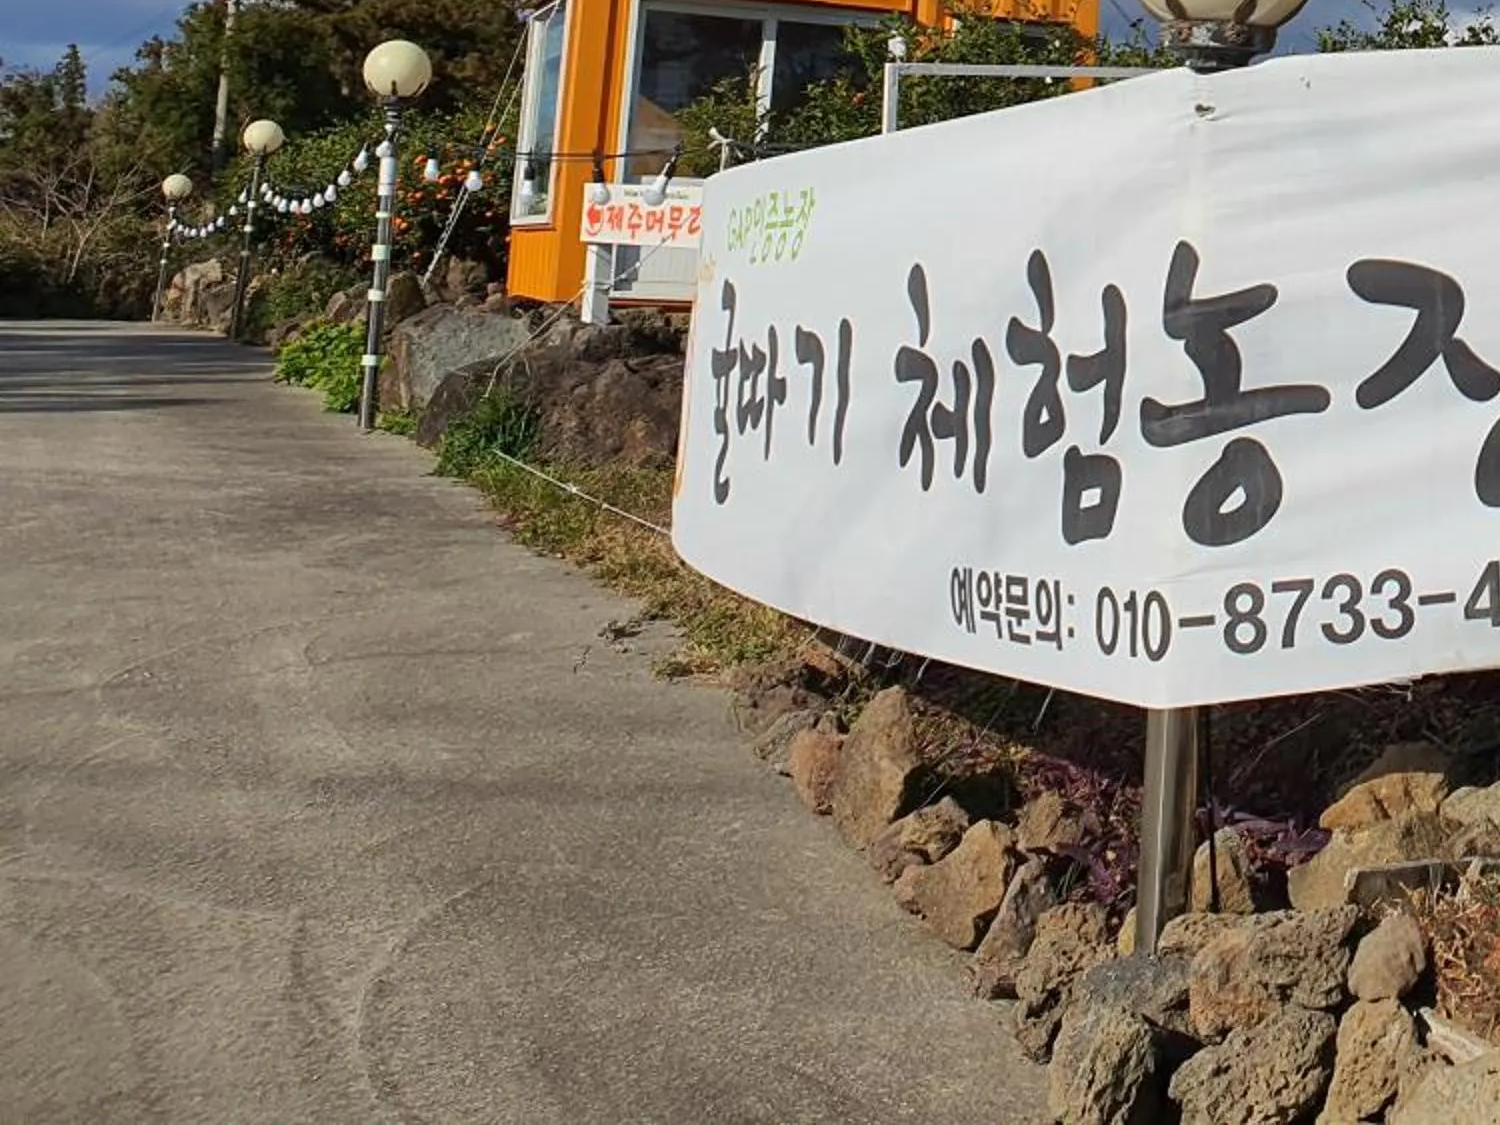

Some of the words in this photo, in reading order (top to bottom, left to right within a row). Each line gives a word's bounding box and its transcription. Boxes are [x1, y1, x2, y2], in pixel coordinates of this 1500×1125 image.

[726, 186, 817, 266] GAP인증농장
[710, 278, 853, 506] 귤따기
[950, 566, 1077, 651] 예약문의:
